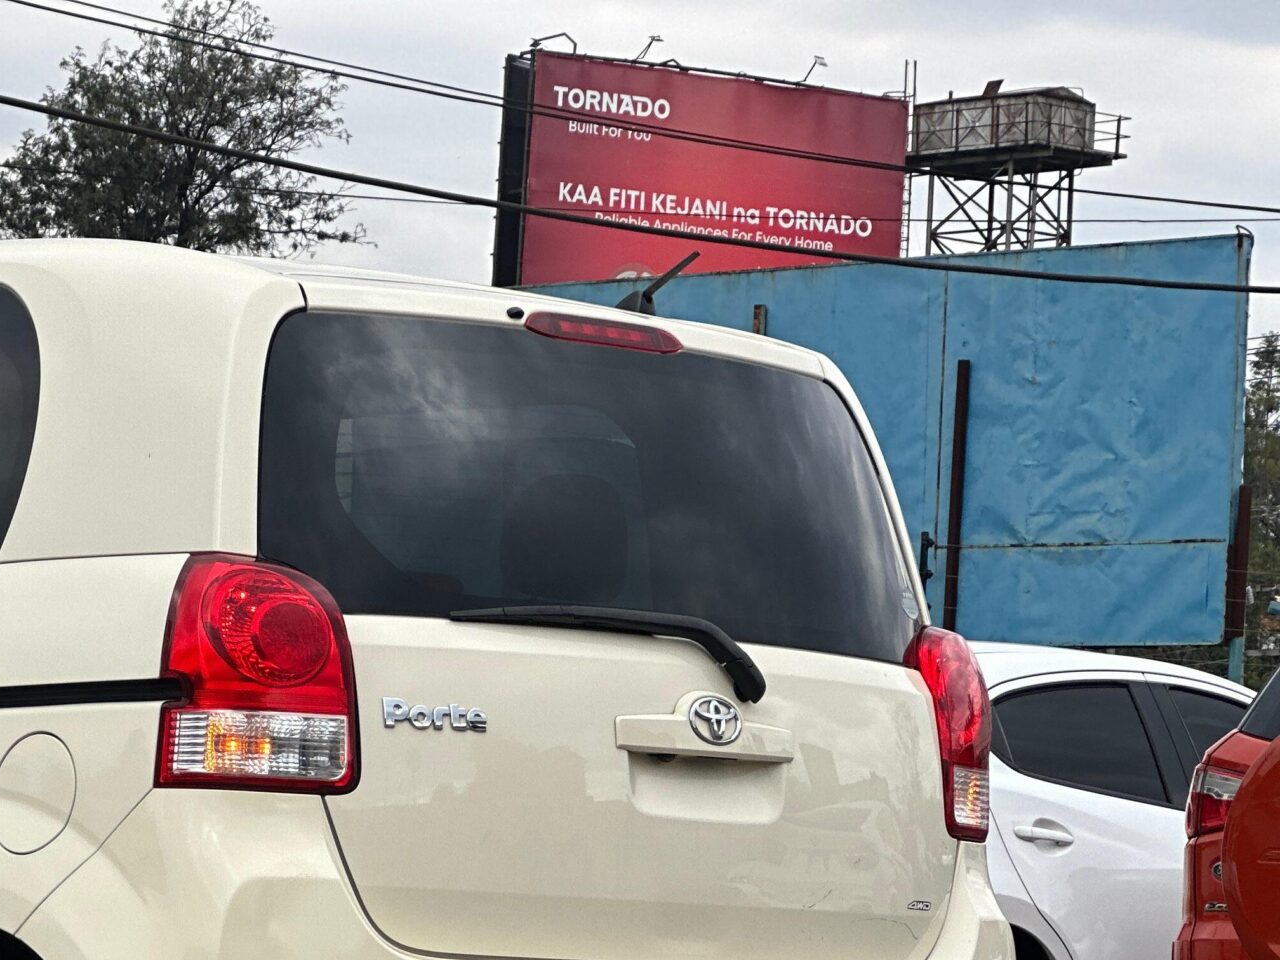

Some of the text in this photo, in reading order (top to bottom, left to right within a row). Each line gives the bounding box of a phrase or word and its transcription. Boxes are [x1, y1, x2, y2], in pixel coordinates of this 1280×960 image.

[553, 85, 671, 120] TORNADO
[568, 119, 600, 136] Built
[558, 181, 873, 238] KAA FITI KEJANI na TORNADO
[794, 235, 834, 252] Home
[382, 696, 487, 733] Porte
